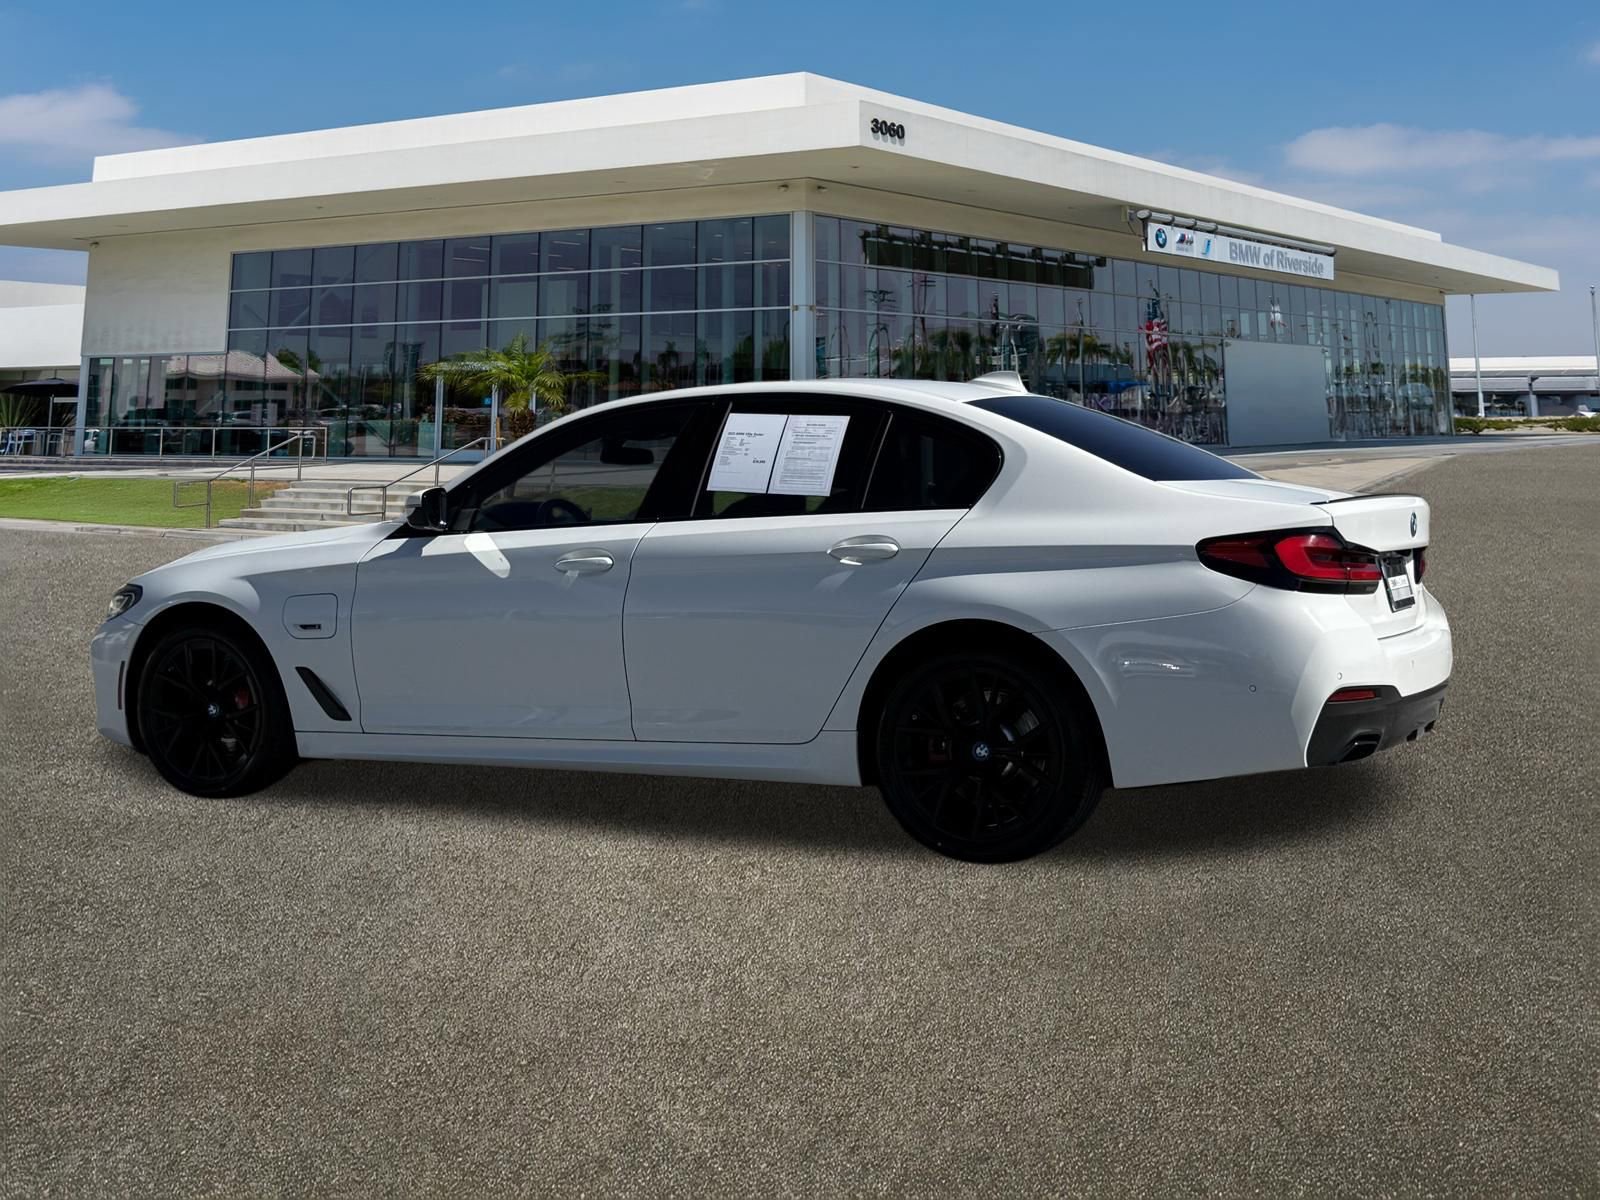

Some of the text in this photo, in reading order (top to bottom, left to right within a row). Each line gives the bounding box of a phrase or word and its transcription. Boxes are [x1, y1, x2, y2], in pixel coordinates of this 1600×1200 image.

[871, 118, 905, 139] 3060
[1229, 241, 1324, 275] BMW of Riverside
